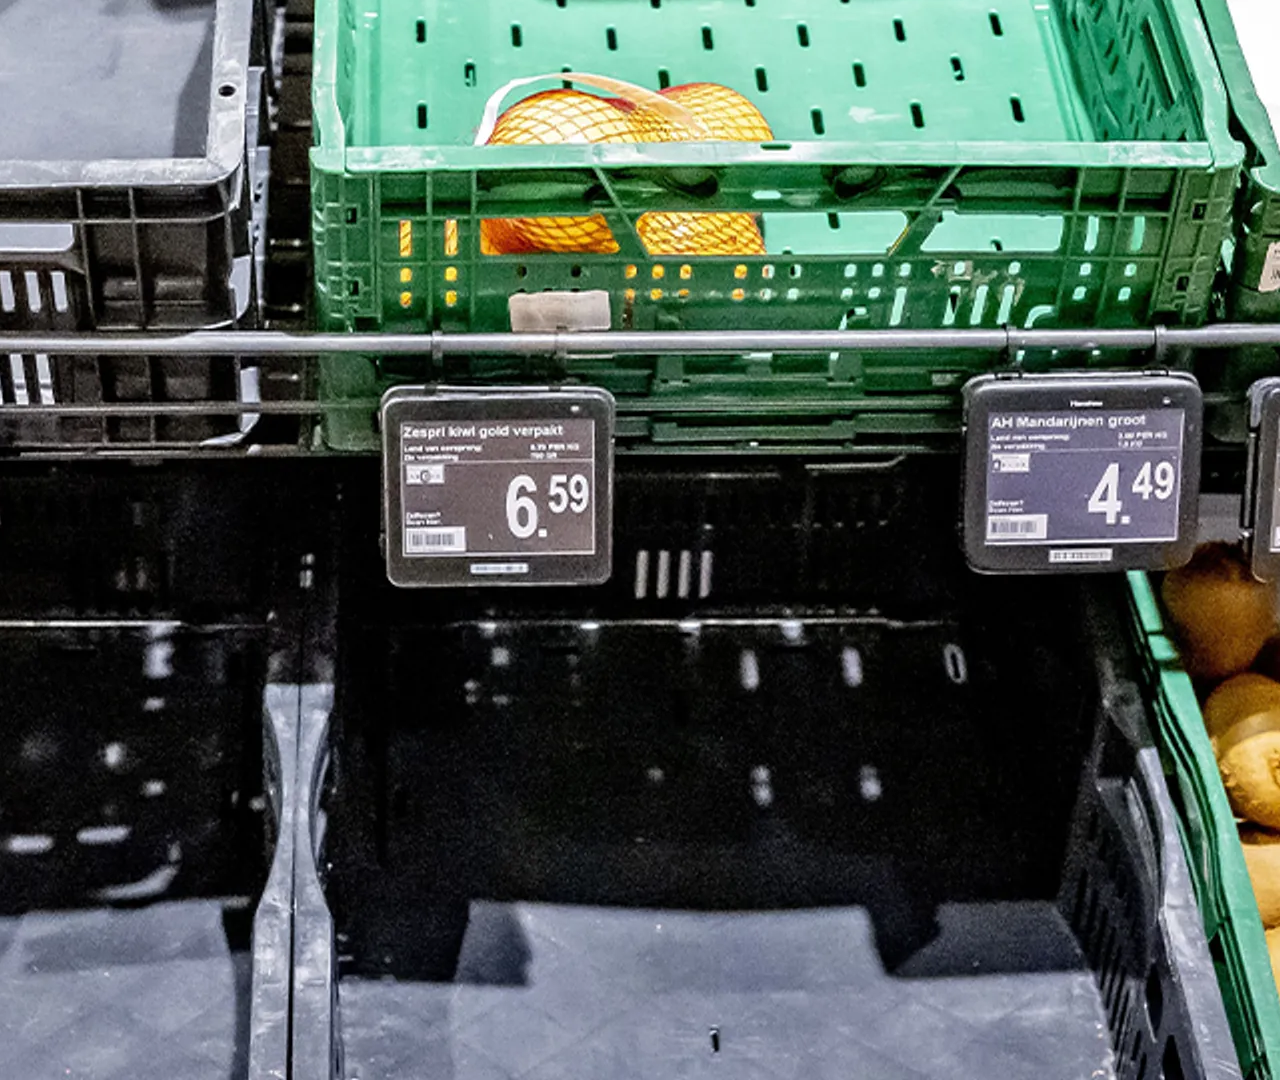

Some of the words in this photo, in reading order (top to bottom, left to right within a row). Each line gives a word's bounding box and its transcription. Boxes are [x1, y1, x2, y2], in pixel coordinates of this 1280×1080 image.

[992, 417, 1013, 428] AH
[1017, 416, 1103, 427] Mandarijnen
[1108, 415, 1145, 427] groot
[403, 427, 445, 438] Zespri
[449, 426, 475, 437] kiwi
[480, 426, 509, 438] gold
[514, 425, 563, 437] verpakt
